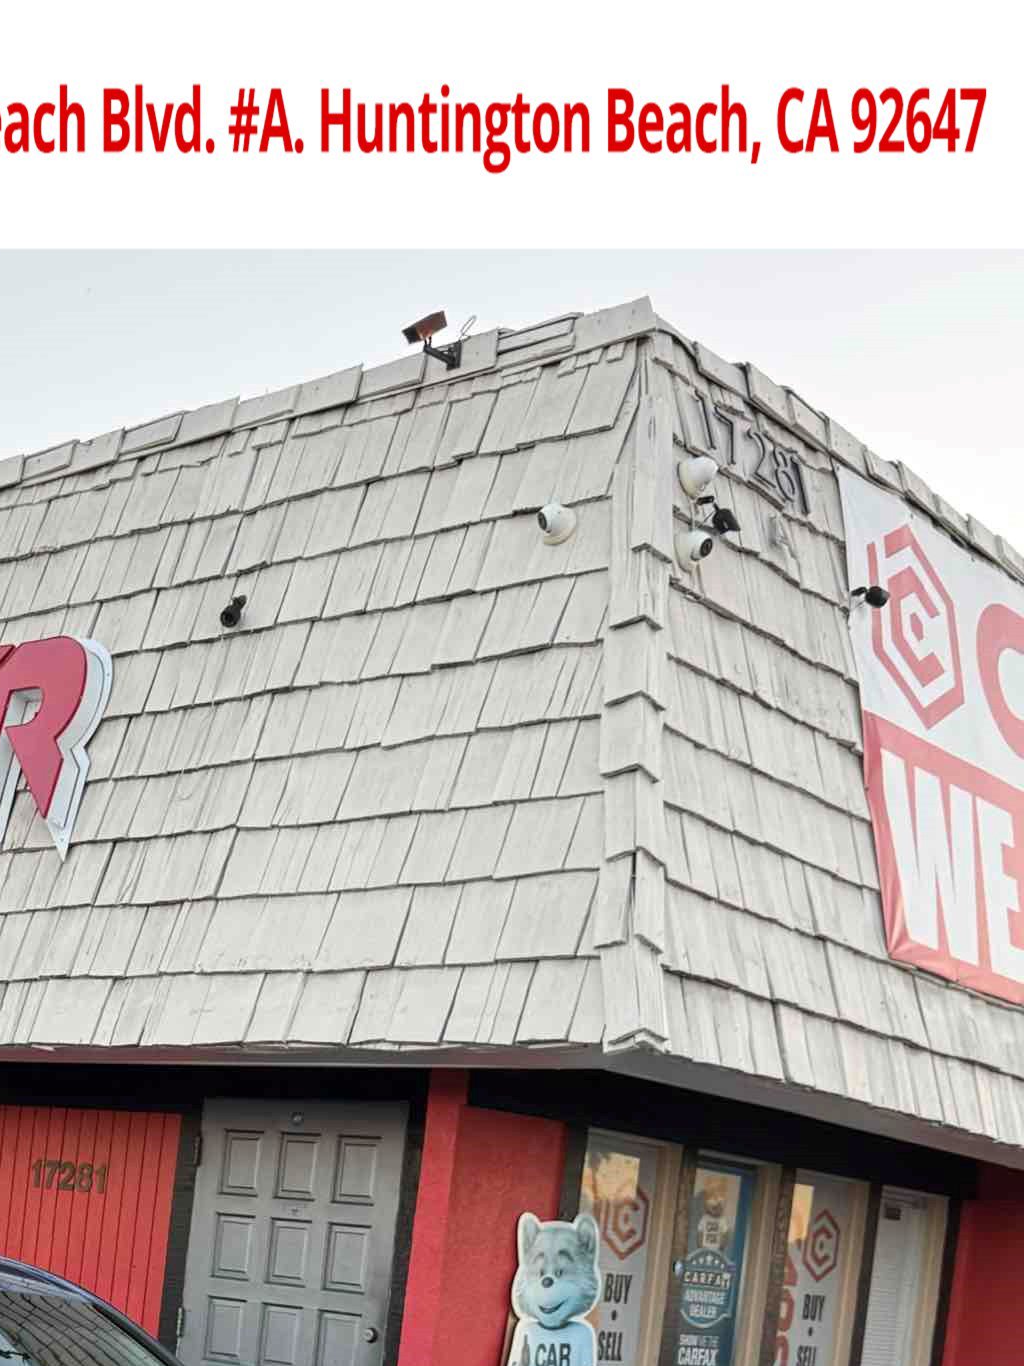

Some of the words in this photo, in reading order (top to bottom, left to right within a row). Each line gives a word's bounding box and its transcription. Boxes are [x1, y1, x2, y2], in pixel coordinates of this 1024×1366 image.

[693, 389, 810, 515] 17281
[32, 1158, 107, 1194] 17281
[603, 1273, 633, 1304] BUY
[802, 1293, 825, 1322] BUY
[597, 1331, 623, 1361] SELL
[677, 1347, 719, 1366] CARFAX
